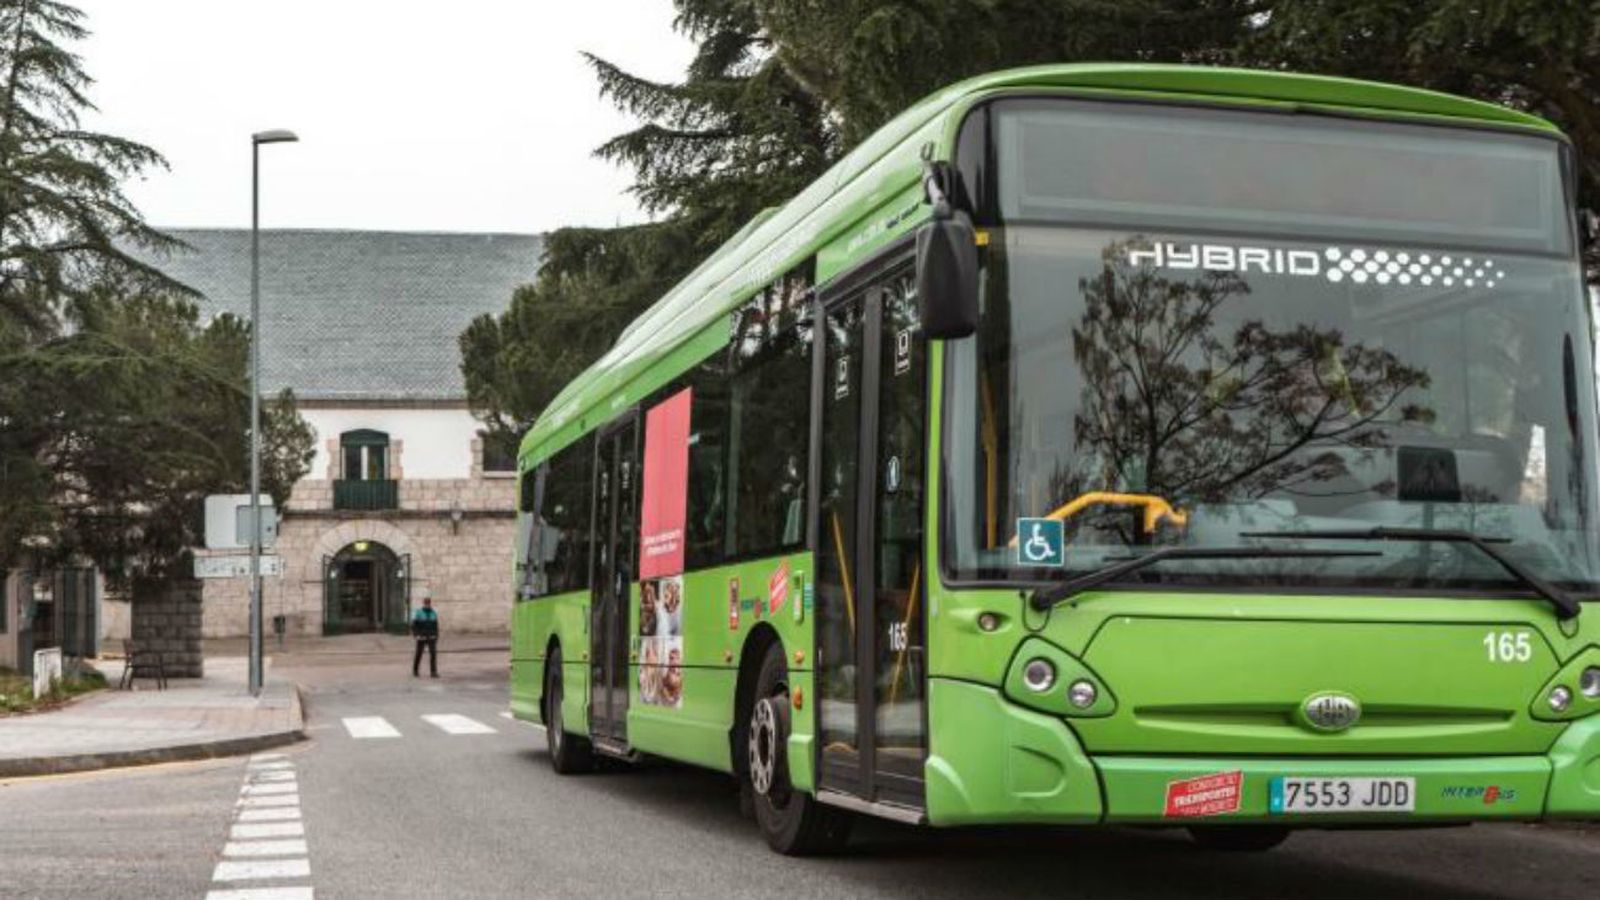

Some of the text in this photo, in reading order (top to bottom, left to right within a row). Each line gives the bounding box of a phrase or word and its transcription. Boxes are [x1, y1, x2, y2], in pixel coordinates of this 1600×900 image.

[1129, 242, 1320, 276] HYBRID
[888, 621, 908, 651] 165
[1483, 631, 1531, 662] 165
[1287, 781, 1409, 808] 7553 JDD
